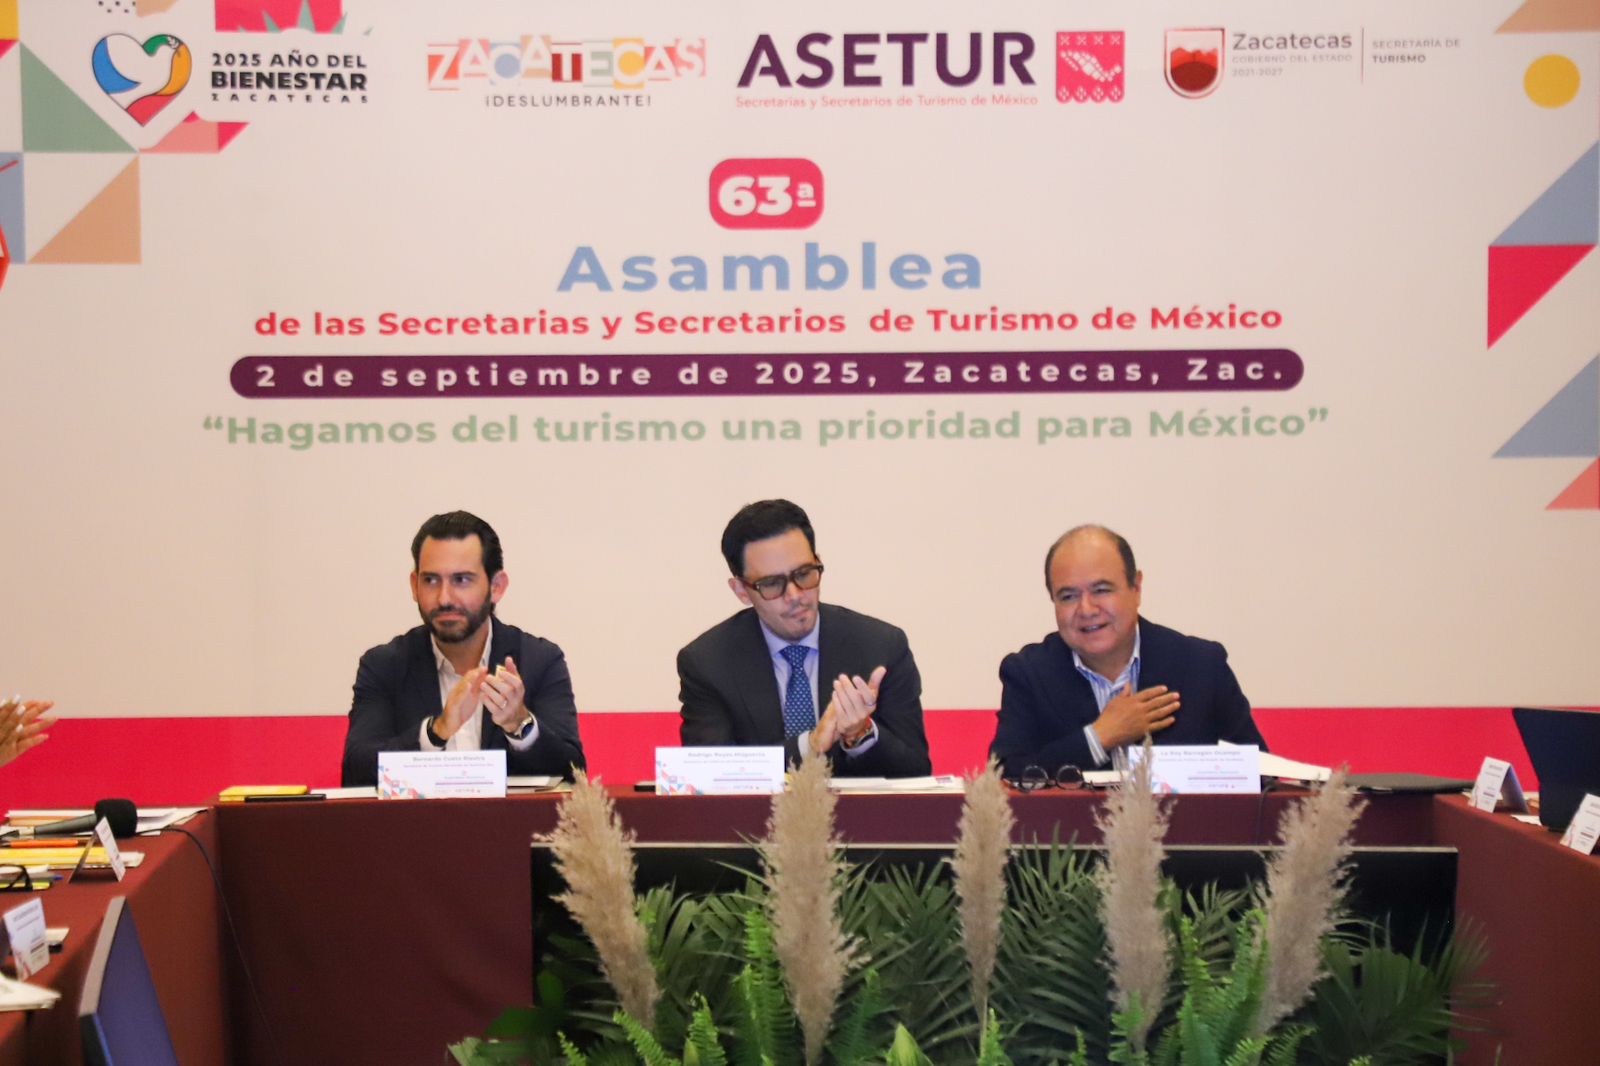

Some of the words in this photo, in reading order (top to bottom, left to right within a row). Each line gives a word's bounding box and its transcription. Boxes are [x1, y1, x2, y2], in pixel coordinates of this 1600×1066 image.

[1233, 33, 1352, 50] Zacatecas
[1373, 38, 1442, 49] SECRETARÍA
[1446, 39, 1459, 48] DE
[213, 53, 261, 66] 2025
[270, 50, 318, 67] AÑO
[327, 55, 366, 68] DEL
[428, 35, 706, 90] ZACATECAS
[737, 32, 1035, 88] ASETUR
[1232, 55, 1286, 63] GOBIERNO
[1290, 55, 1307, 63] DEL
[1312, 54, 1352, 62] ESTADO
[1373, 54, 1426, 63] TURISMO
[211, 71, 366, 90] BIENESTAR
[212, 93, 367, 103] ZACATECAS
[810, 99, 817, 110] y
[821, 96, 892, 107] Secretarios
[896, 95, 913, 106] de
[917, 94, 967, 106] Turismo
[971, 94, 987, 105] de
[992, 94, 1038, 105] México
[717, 175, 816, 216] 63ª
[557, 242, 981, 292] Asamblea
[255, 312, 300, 335] de
[315, 312, 365, 335] las
[378, 309, 589, 336] Secretarias
[602, 317, 622, 340] y
[635, 308, 846, 334] Secretarios
[870, 309, 914, 332] de
[927, 306, 1078, 331] Turismo
[1092, 307, 1136, 330] de
[1151, 304, 1282, 329] México
[257, 365, 275, 386] 2
[303, 364, 353, 386] de
[382, 363, 650, 391] septiembre
[678, 362, 728, 384] de
[756, 362, 876, 387] 2025,
[904, 361, 1158, 384] Zacatecas,
[1188, 358, 1281, 380] Zac.
[203, 416, 436, 451] “Hagamos
[452, 415, 518, 443] del
[533, 412, 706, 442] turismo
[722, 419, 801, 441] una
[819, 409, 1020, 447] prioridad
[1038, 416, 1132, 445] para
[1150, 406, 1328, 437] México”
